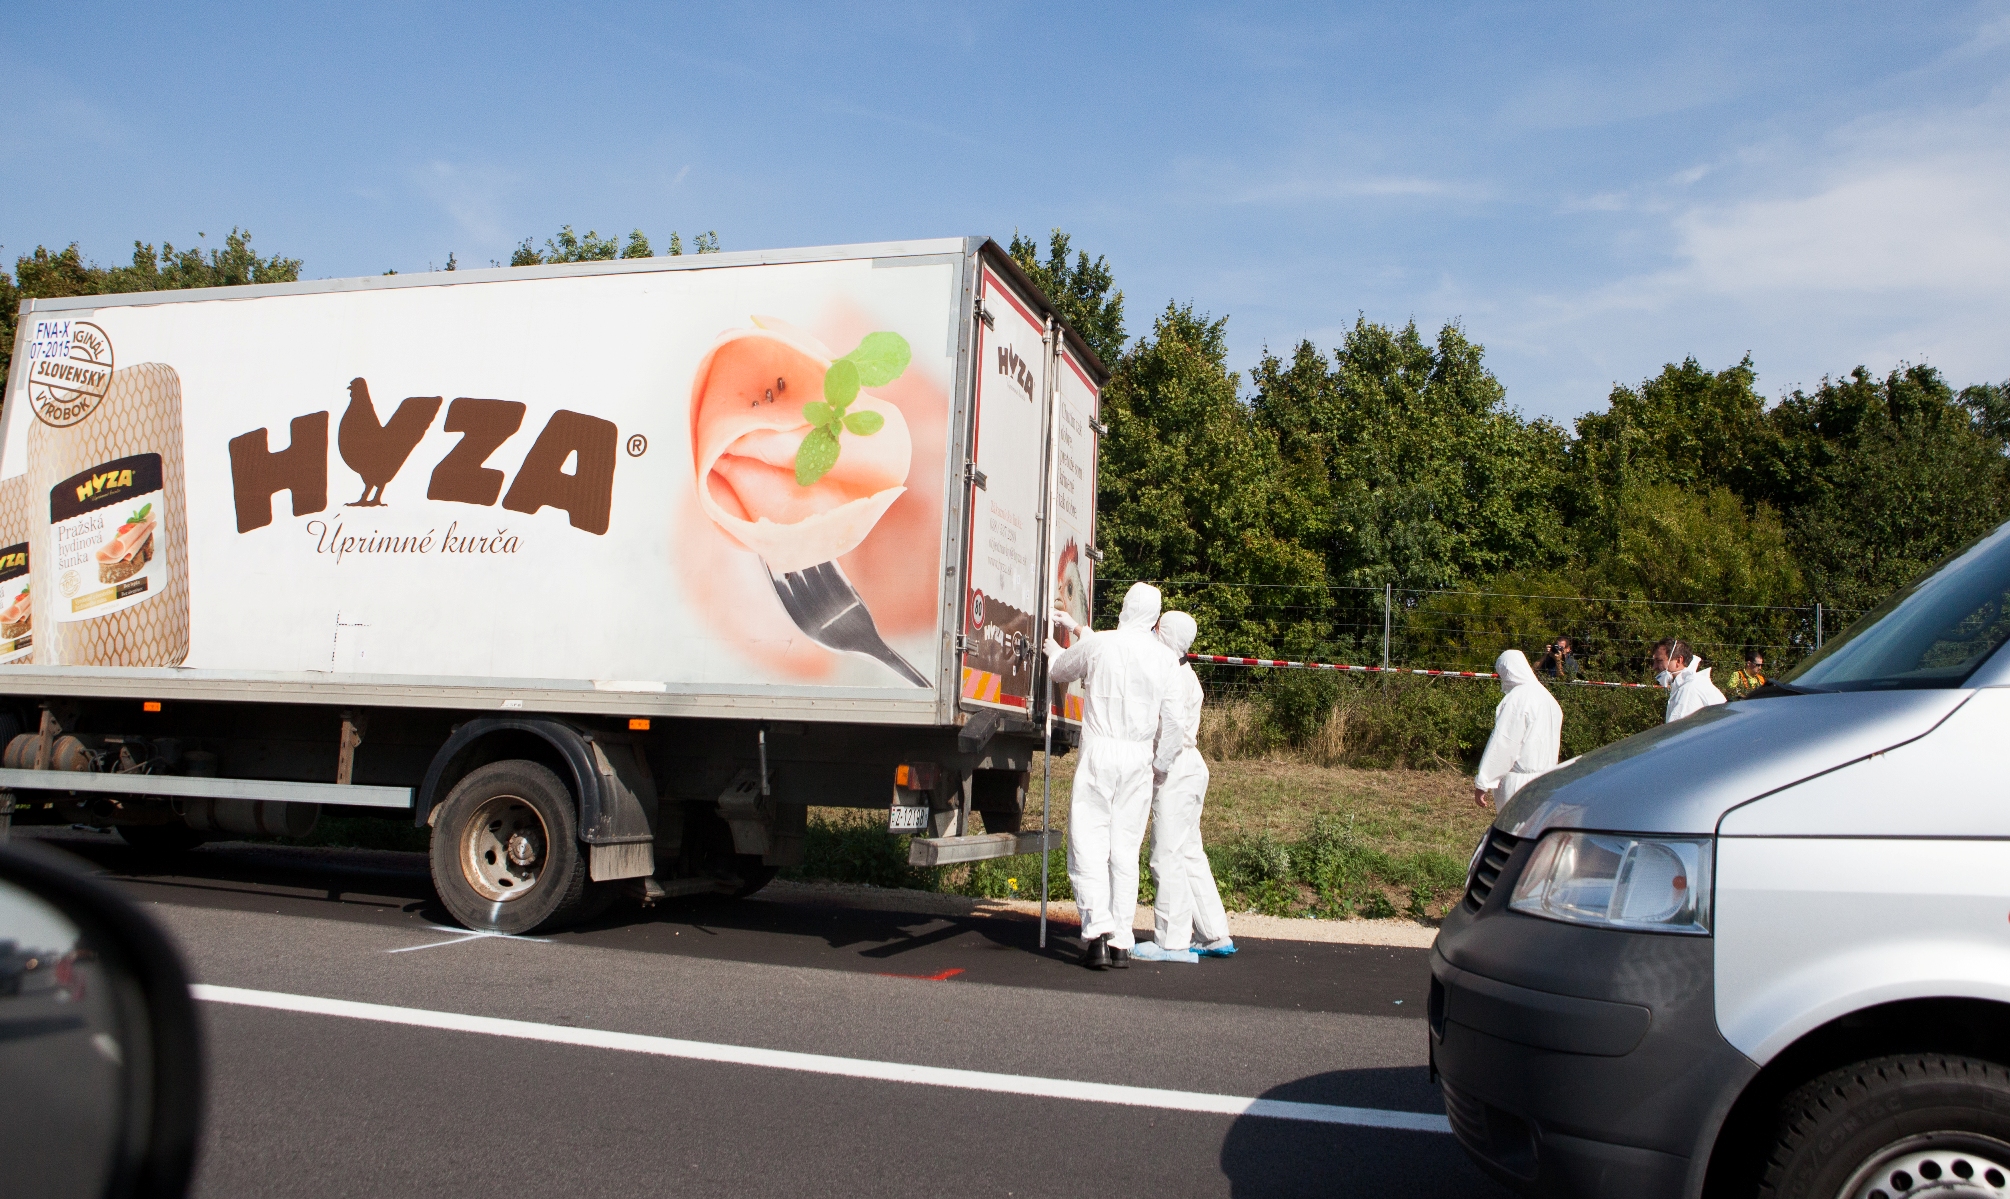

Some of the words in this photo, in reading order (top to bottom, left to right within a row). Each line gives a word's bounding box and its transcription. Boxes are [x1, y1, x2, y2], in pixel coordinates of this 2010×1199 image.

[36, 321, 71, 340] FNA-X
[72, 330, 105, 360] IGINÁL
[30, 340, 71, 359] 07-2015
[37, 360, 107, 387] SLOVENSKÝ
[997, 342, 1034, 404] HYZA
[35, 390, 91, 421] VÝROBOK
[228, 376, 618, 536] HYZA
[76, 469, 133, 503] HYZA
[58, 513, 104, 542] Pražská
[306, 512, 437, 566] Úprimné
[441, 520, 525, 554] kurča
[58, 530, 103, 557] hydinová
[0, 552, 26, 571] YZA
[58, 552, 89, 571] šunka
[1788, 1092, 1902, 1199] 05/65R16C
